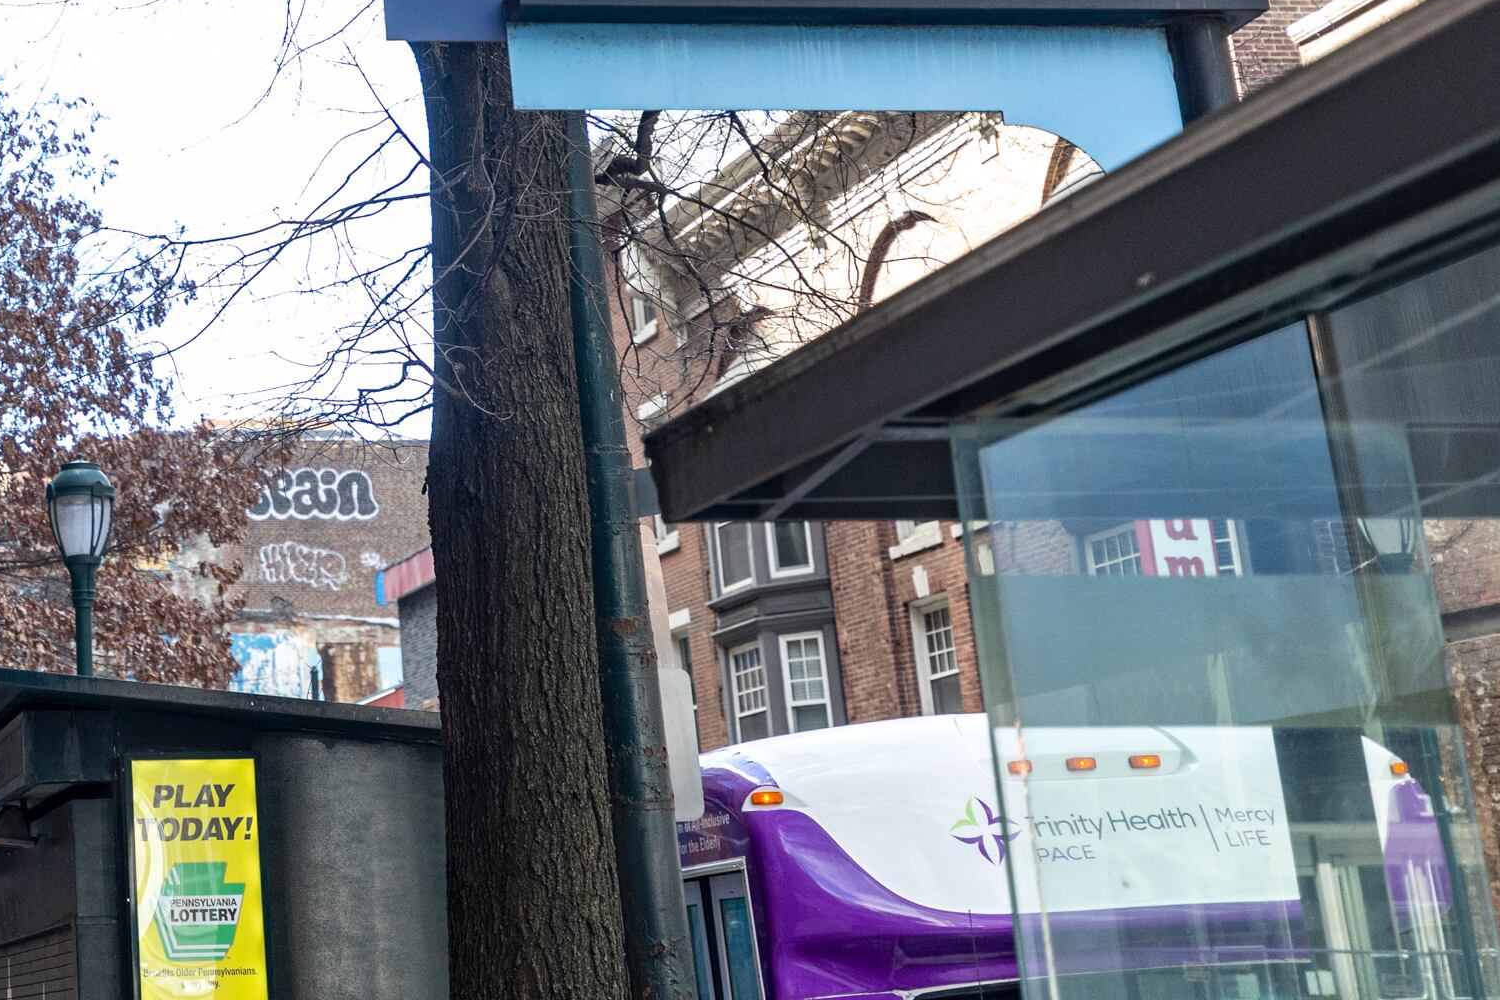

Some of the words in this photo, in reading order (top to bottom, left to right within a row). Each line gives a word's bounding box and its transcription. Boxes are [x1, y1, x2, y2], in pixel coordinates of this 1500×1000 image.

[153, 783, 236, 809] PLAY
[136, 816, 253, 842] TODAY!
[1106, 806, 1197, 833] Health
[1214, 806, 1276, 826] Mercy
[1224, 829, 1272, 848] LIFE
[1036, 844, 1097, 863] PACE
[170, 897, 238, 908] PENNSYLVANIA
[170, 908, 238, 922] LOTTERY
